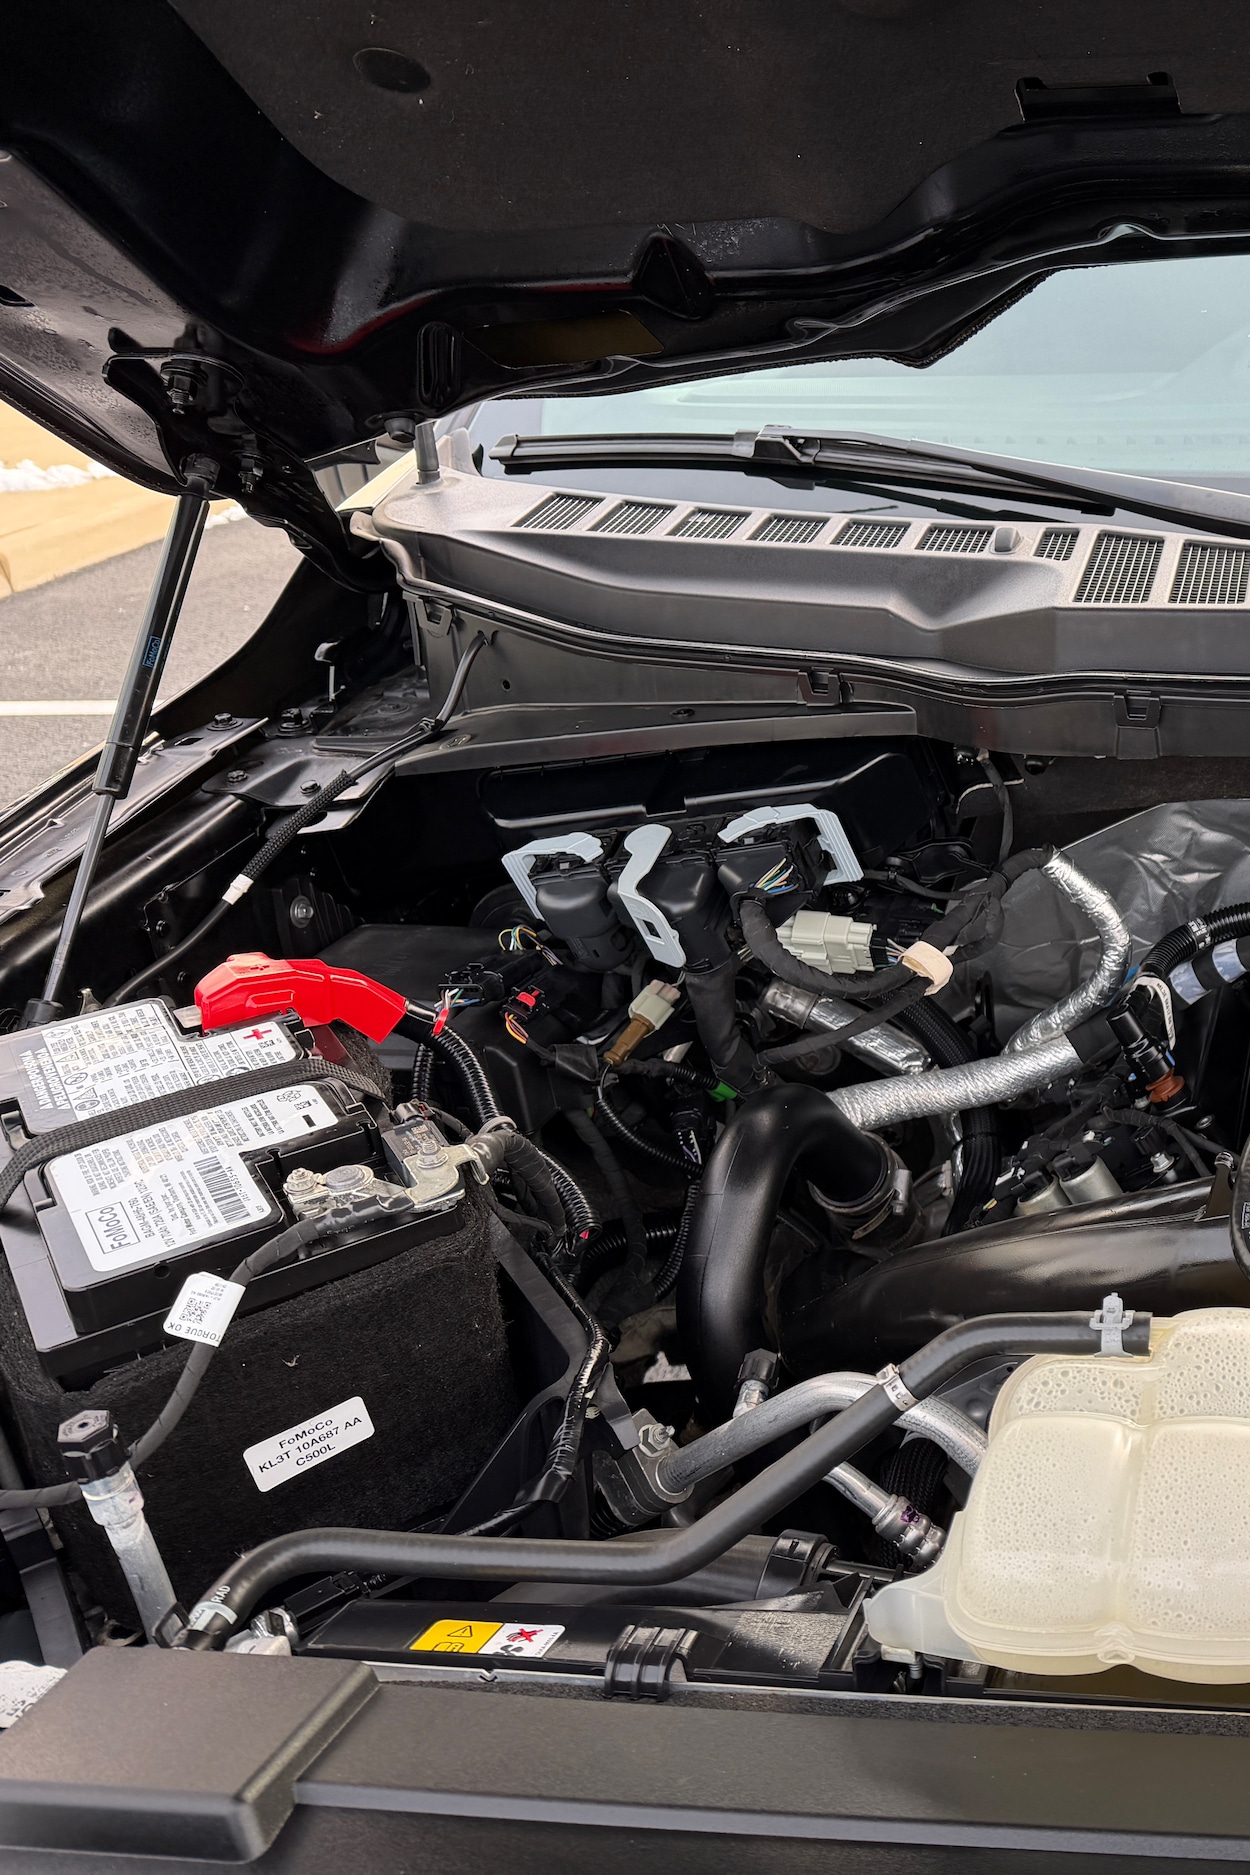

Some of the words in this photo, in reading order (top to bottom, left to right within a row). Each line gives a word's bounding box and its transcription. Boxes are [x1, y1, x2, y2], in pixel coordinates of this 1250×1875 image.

[98, 1207, 131, 1249] FoMoCo
[168, 1322, 182, 1331] OK
[185, 1326, 220, 1342] TORQUE
[258, 1450, 293, 1473] KL3T
[295, 1427, 340, 1453] 10A687
[344, 1417, 362, 1430] AA
[278, 1419, 333, 1449] FoMoCo
[295, 1444, 336, 1467] C500L
[210, 1585, 231, 1603] RAD
